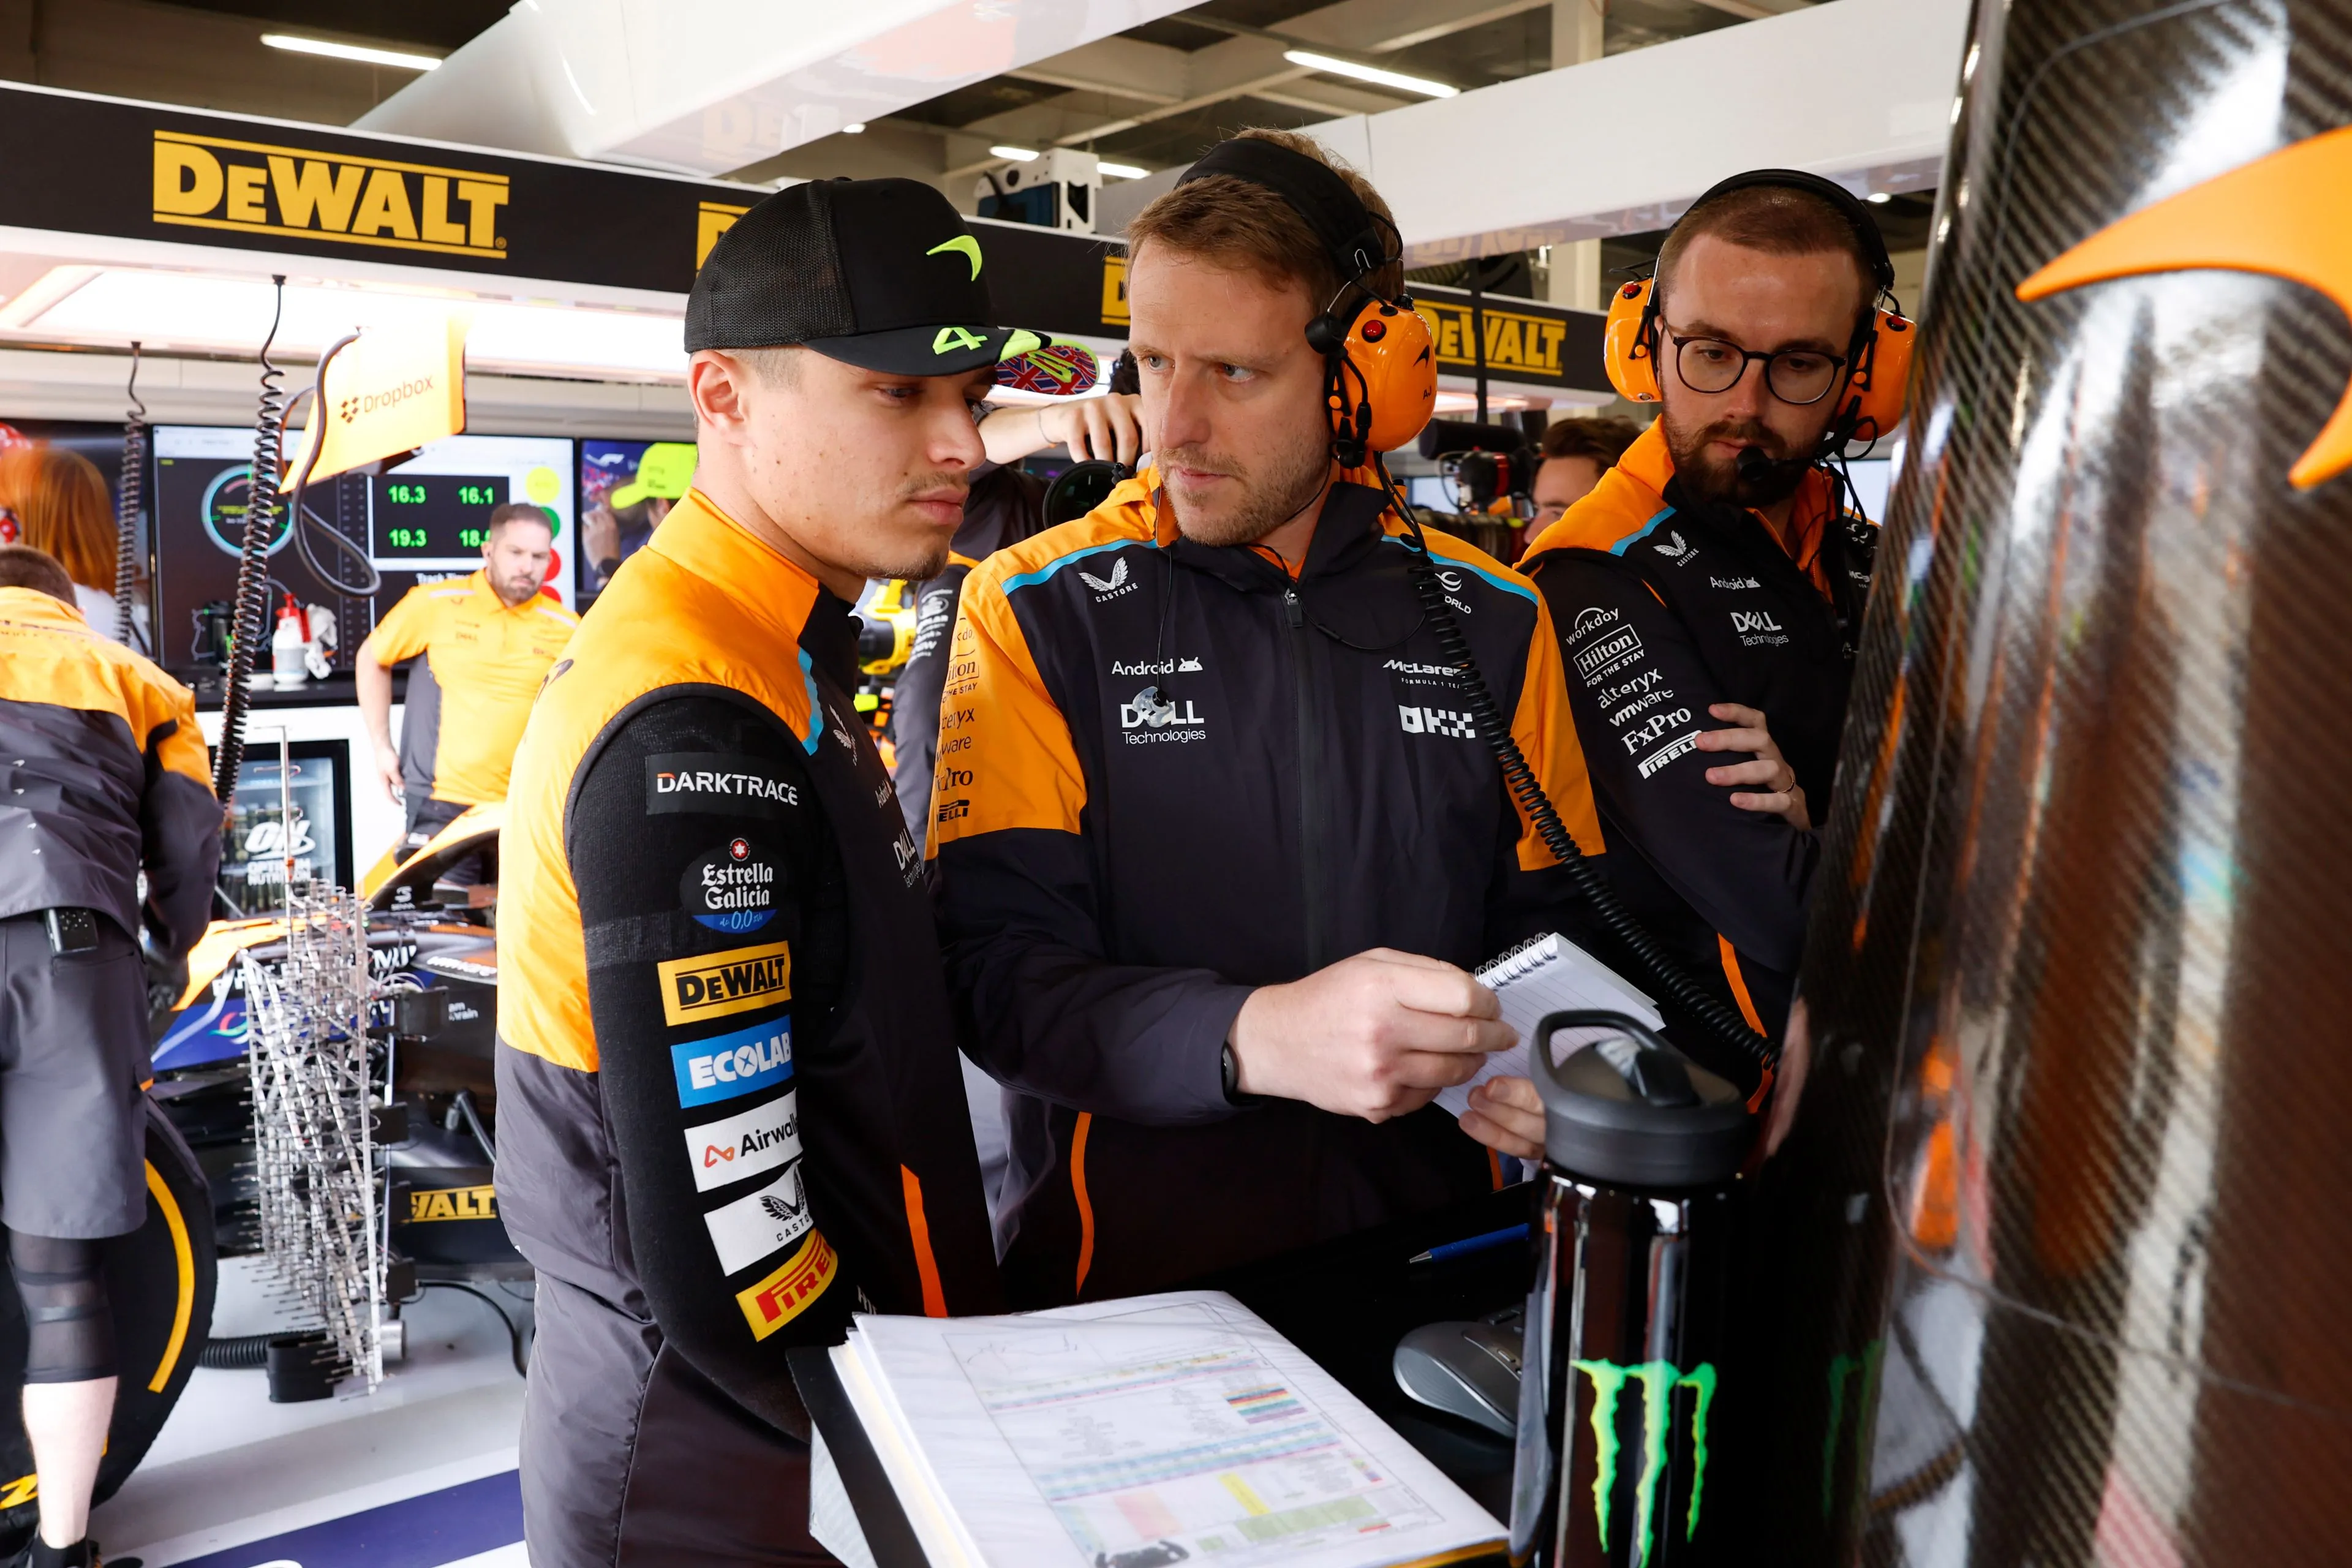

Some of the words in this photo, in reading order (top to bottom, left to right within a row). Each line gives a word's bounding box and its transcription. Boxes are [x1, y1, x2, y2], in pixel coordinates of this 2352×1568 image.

[154, 141, 508, 249] DEWALT
[933, 326, 988, 355] 4
[364, 376, 434, 413] Dropbox
[388, 485, 426, 504] 16.3
[458, 486, 494, 505] 16.1
[388, 529, 427, 548] 19.3
[1676, 548, 1699, 567] CASTORE
[1095, 582, 1139, 603] CASTORE
[1709, 576, 1746, 590] Android
[1444, 594, 1472, 614] ORLD
[1566, 608, 1619, 646] workday
[1730, 611, 1782, 633] DELL
[1740, 633, 1789, 647] Technologies
[1578, 634, 1634, 673] Hilton
[947, 661, 976, 682] ilton
[1112, 658, 1174, 676] Android
[1586, 675, 1604, 688] FOR
[1602, 662, 1621, 678] THE
[1621, 648, 1645, 667] STAY
[959, 682, 978, 694] STAY
[1401, 677, 1438, 686] FORMULA
[1597, 668, 1664, 709] alteryx
[1120, 700, 1205, 728] DLL
[1609, 689, 1674, 727] vmware
[1121, 729, 1206, 745] Technologies
[1621, 707, 1692, 756] FxPro
[657, 771, 798, 806] DARKTRACE
[701, 862, 774, 886] Estrella
[705, 884, 771, 910] Galicia
[731, 909, 753, 930] 0,0
[676, 957, 785, 1006] DEWALT
[688, 1031, 792, 1090] ECOLAB
[741, 1112, 797, 1157] Airwall
[776, 1213, 810, 1242] CASTO
